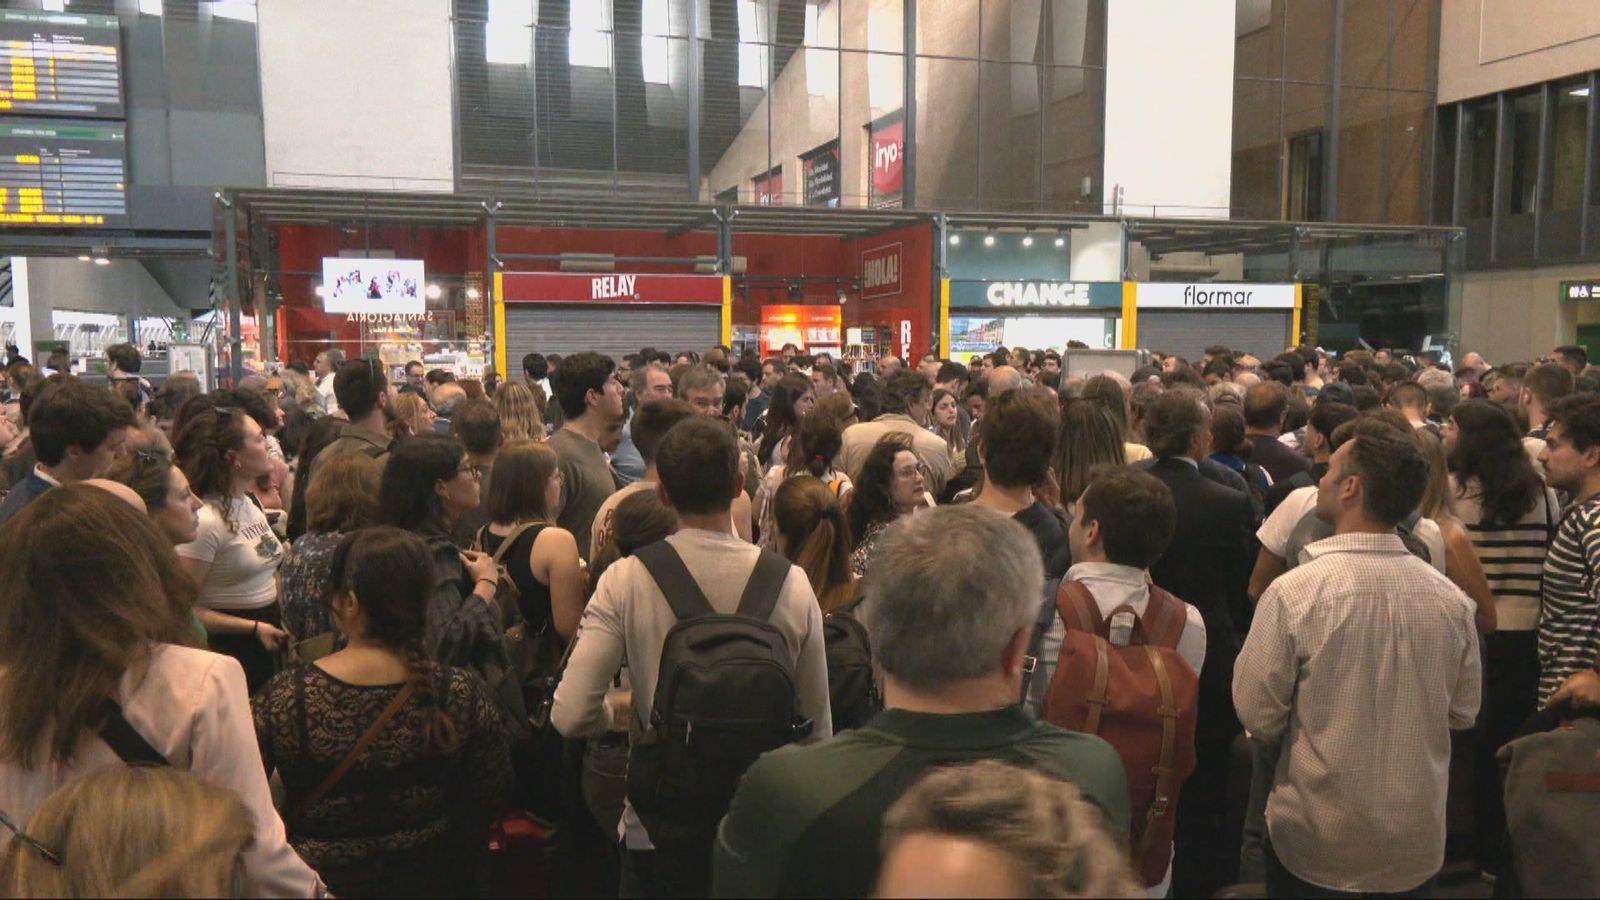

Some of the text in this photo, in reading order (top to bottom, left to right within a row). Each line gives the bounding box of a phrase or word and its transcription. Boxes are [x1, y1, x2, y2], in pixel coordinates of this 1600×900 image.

[876, 142, 897, 173] iryo
[592, 275, 636, 299] RELAY
[987, 282, 1090, 306] CHANGE
[1184, 285, 1253, 305] flormar
